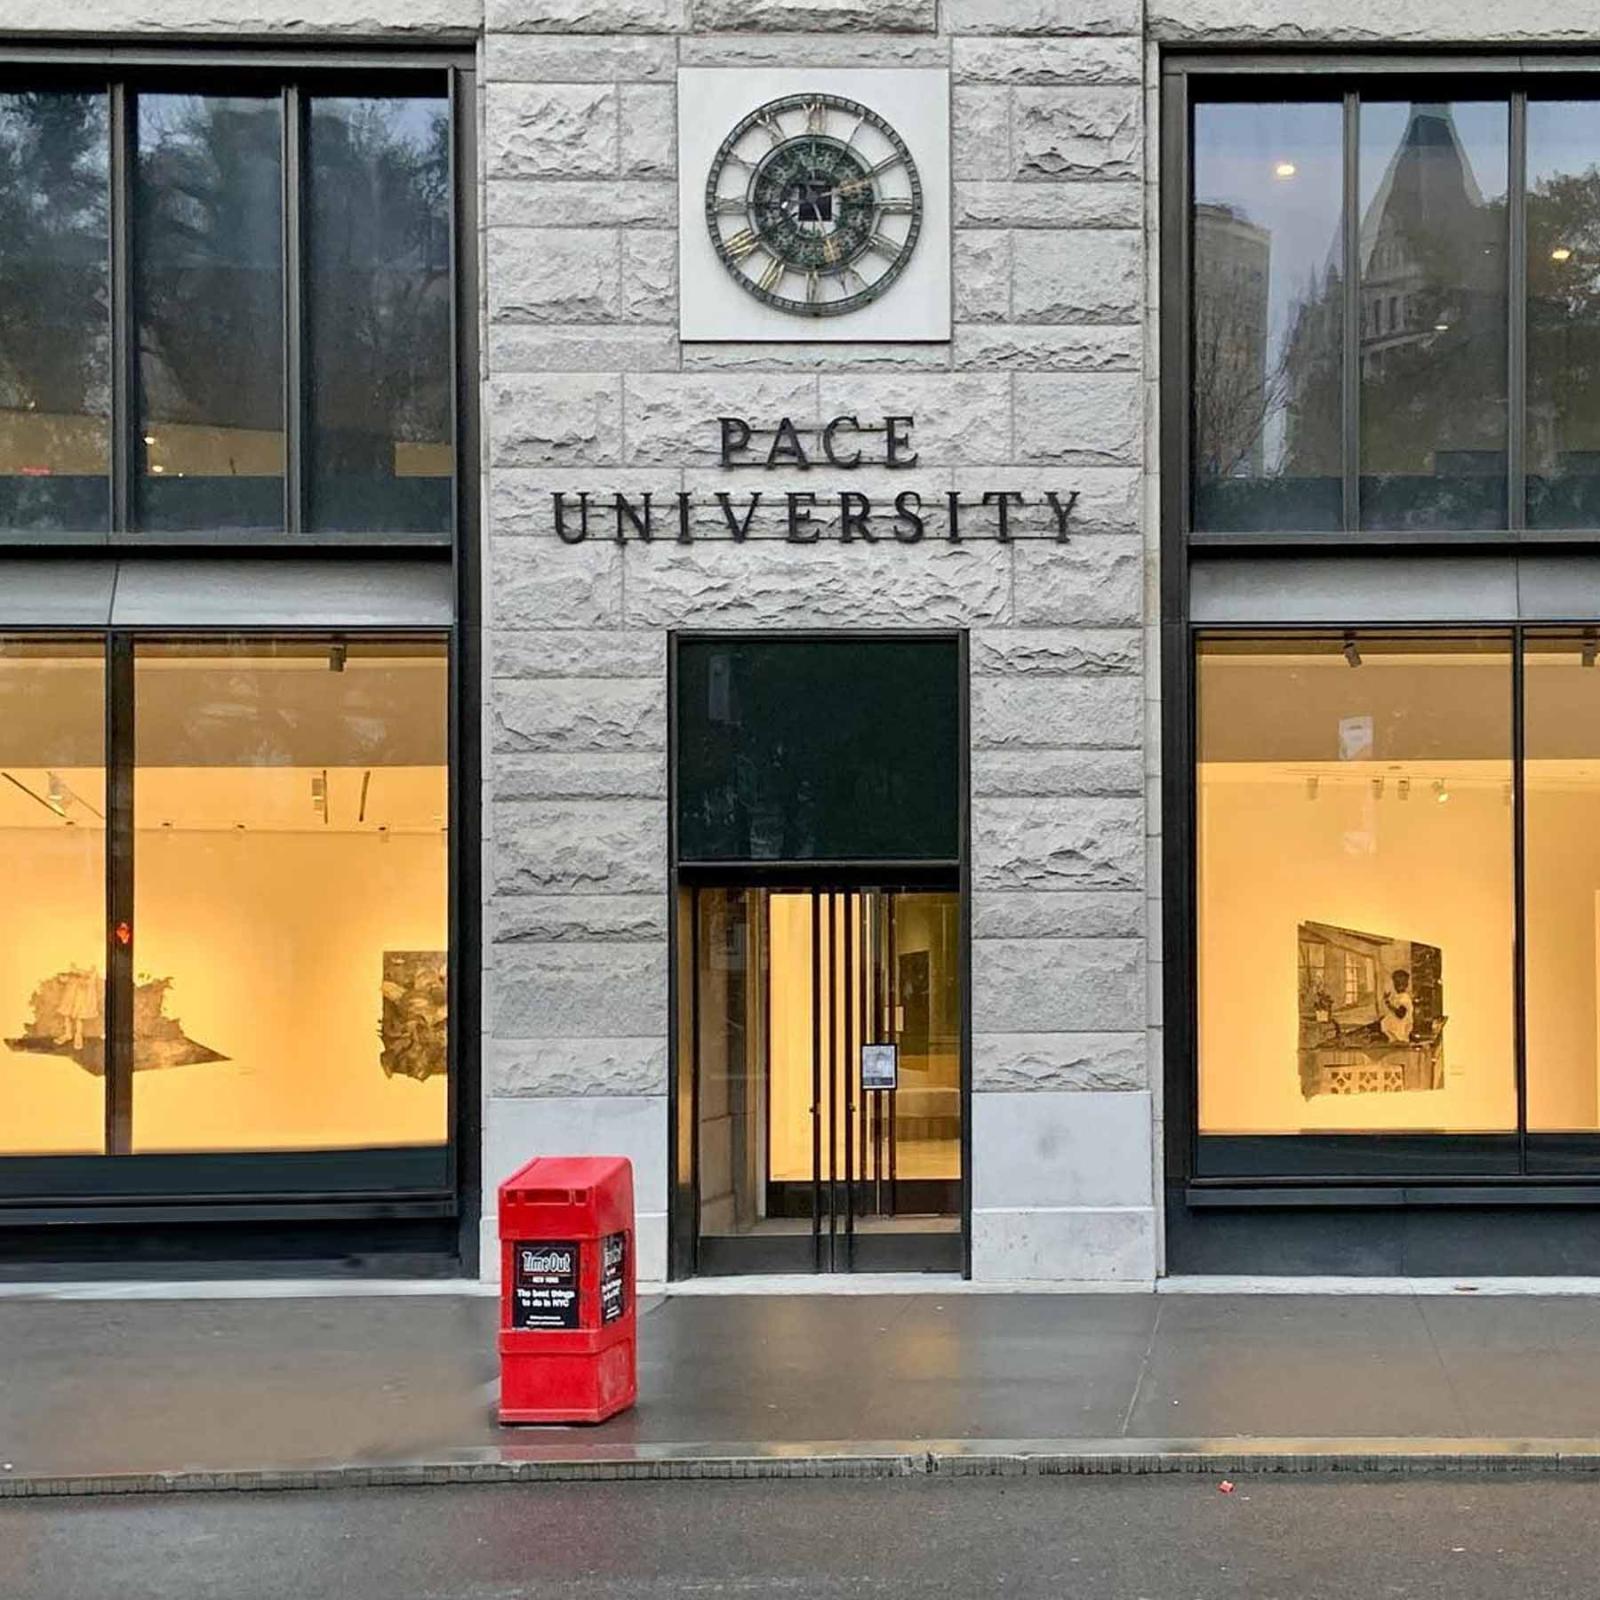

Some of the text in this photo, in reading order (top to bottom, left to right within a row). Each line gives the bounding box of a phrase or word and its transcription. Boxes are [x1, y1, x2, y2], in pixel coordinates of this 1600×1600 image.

[717, 416, 920, 470] PACE
[551, 491, 1082, 545] UNIVERSITY
[517, 1289, 576, 1300] The best things
[522, 1299, 570, 1308] to do in NYC
